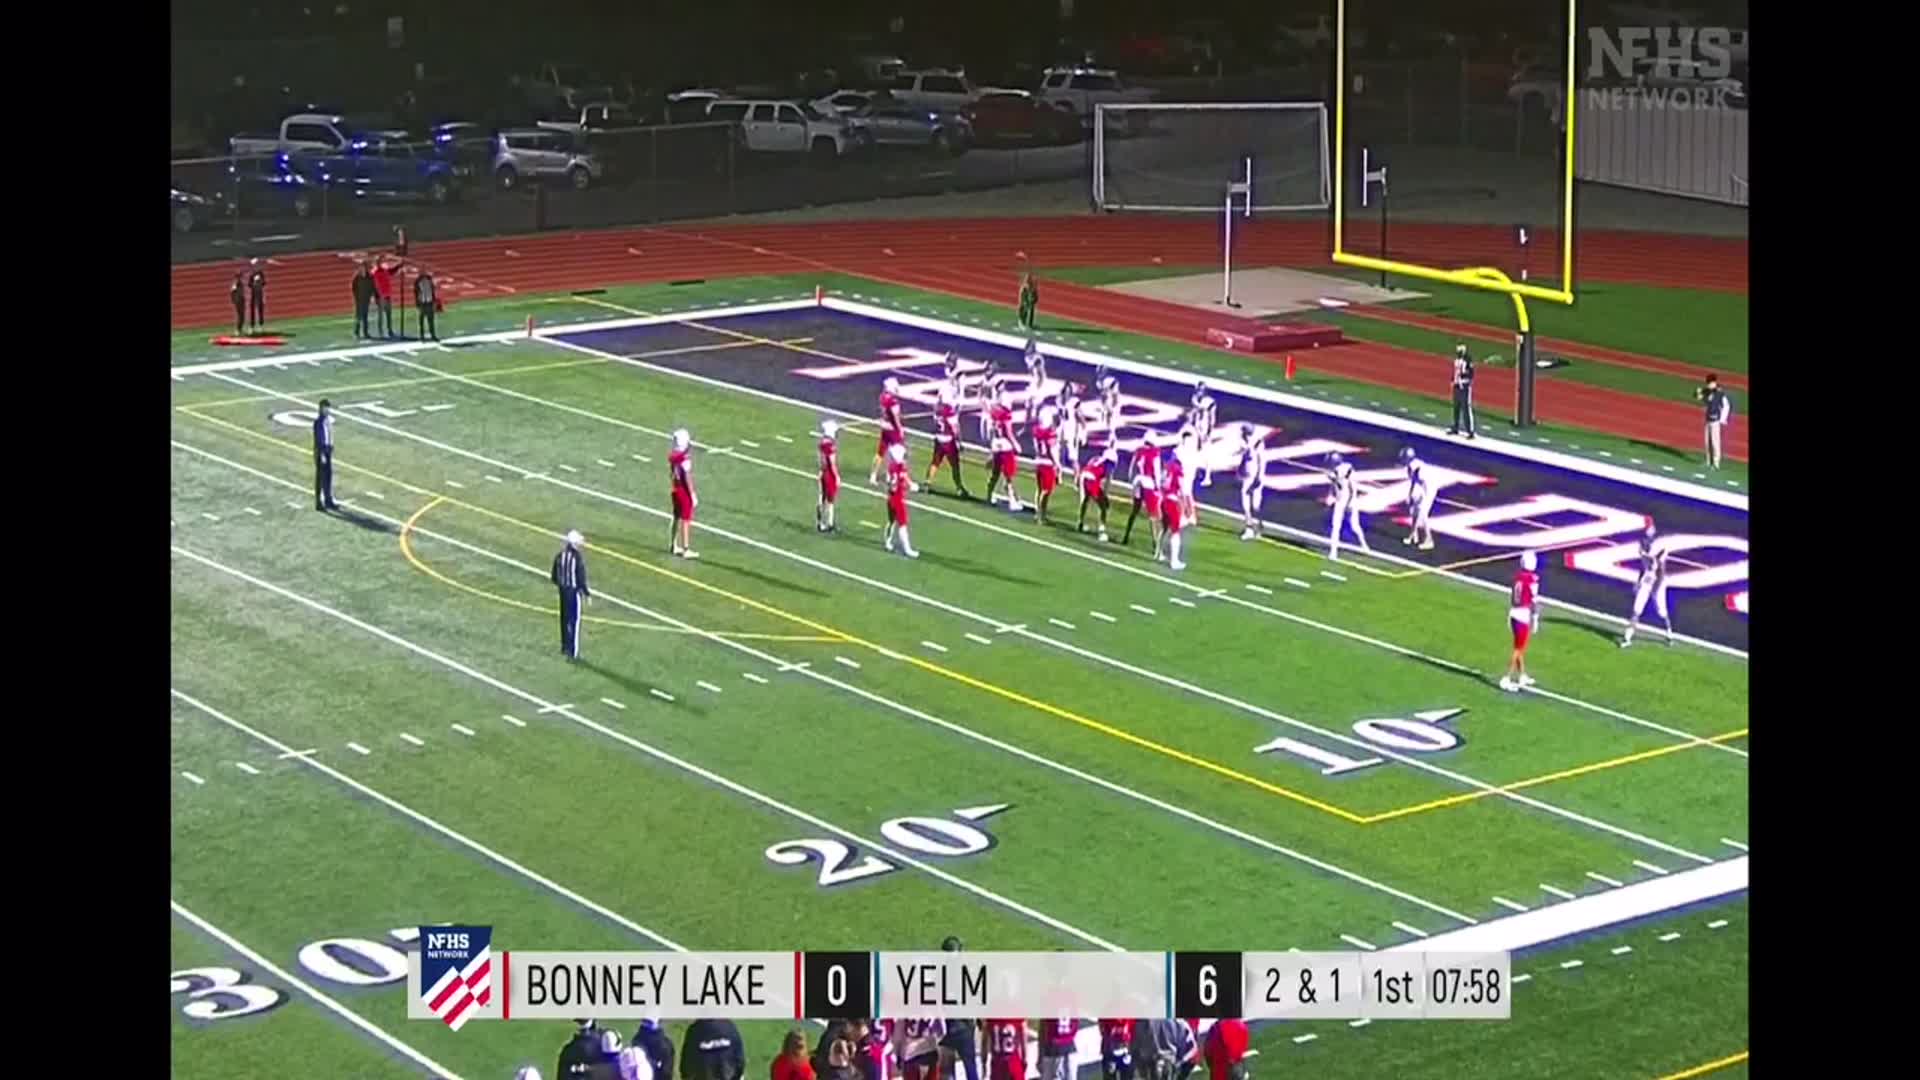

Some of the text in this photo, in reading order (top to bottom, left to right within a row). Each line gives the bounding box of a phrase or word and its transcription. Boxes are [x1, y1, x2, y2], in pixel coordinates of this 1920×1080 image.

[1253, 718, 1457, 774] 10
[765, 817, 989, 885] 20
[171, 938, 409, 1019] 30
